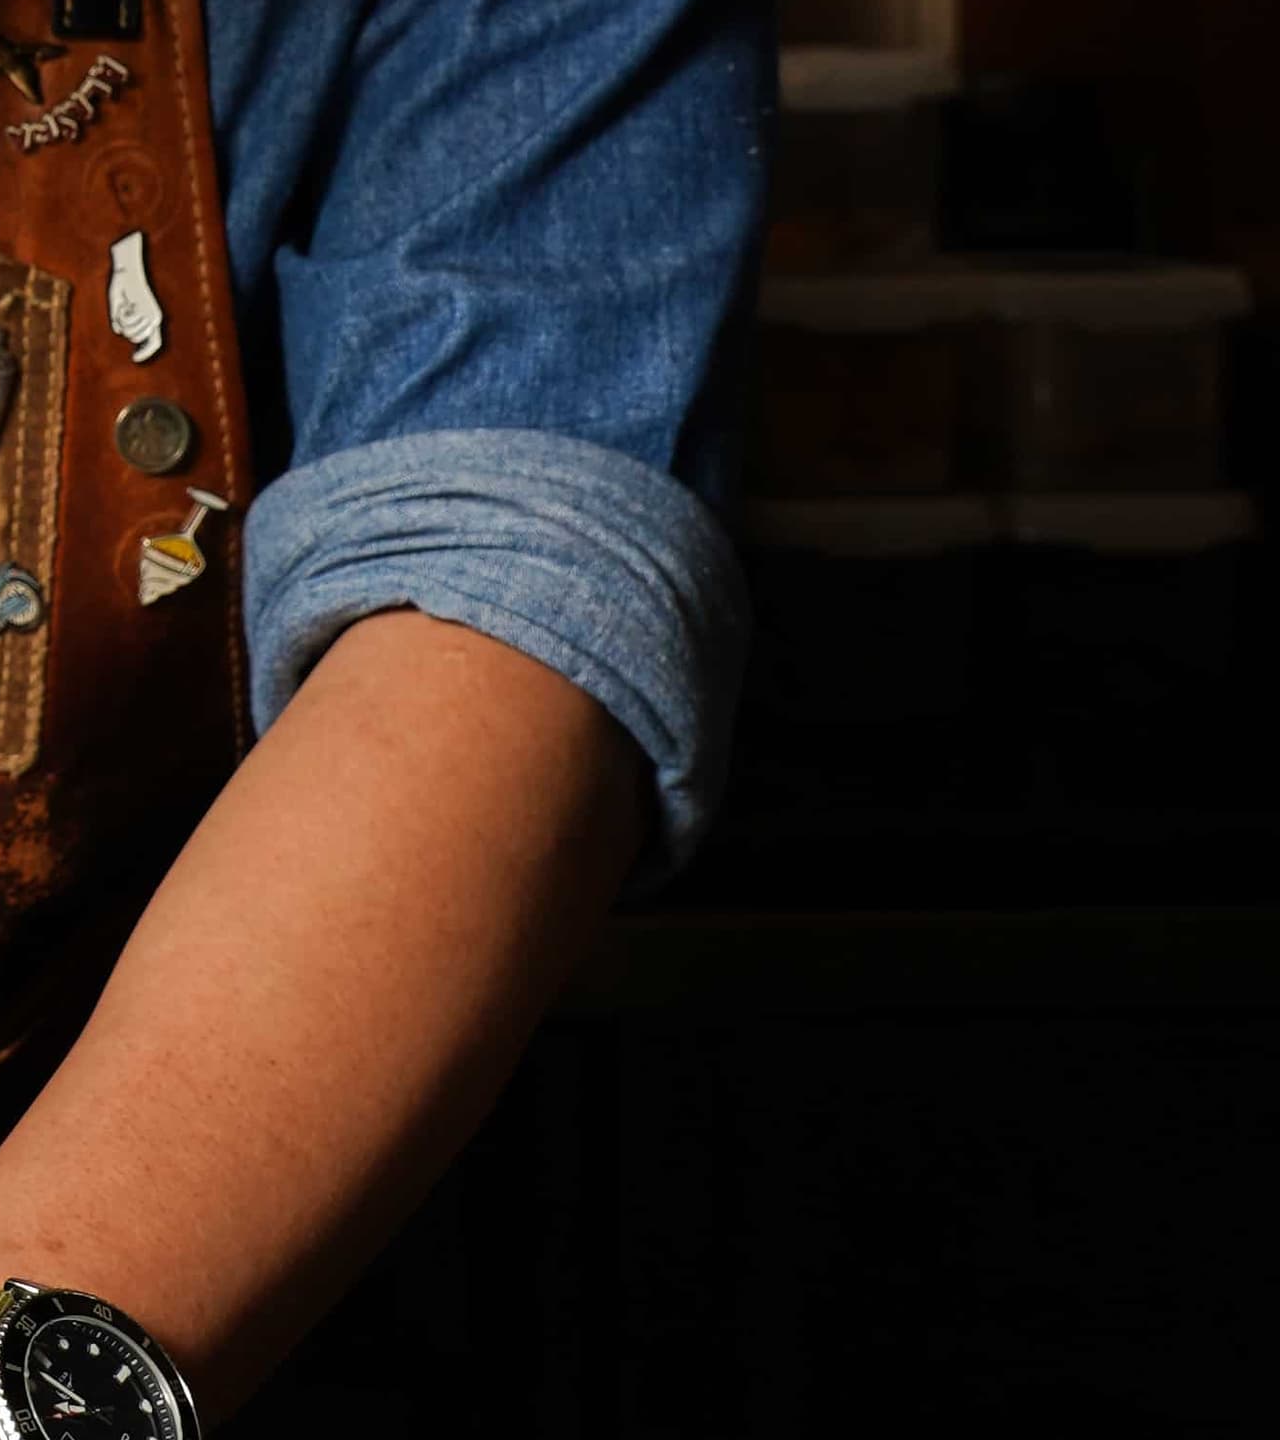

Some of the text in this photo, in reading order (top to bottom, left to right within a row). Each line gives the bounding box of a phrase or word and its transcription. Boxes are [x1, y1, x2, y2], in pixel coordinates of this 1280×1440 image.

[93, 1303, 112, 1321] 40
[15, 1314, 37, 1337] 30
[15, 1408, 38, 1433] 20
